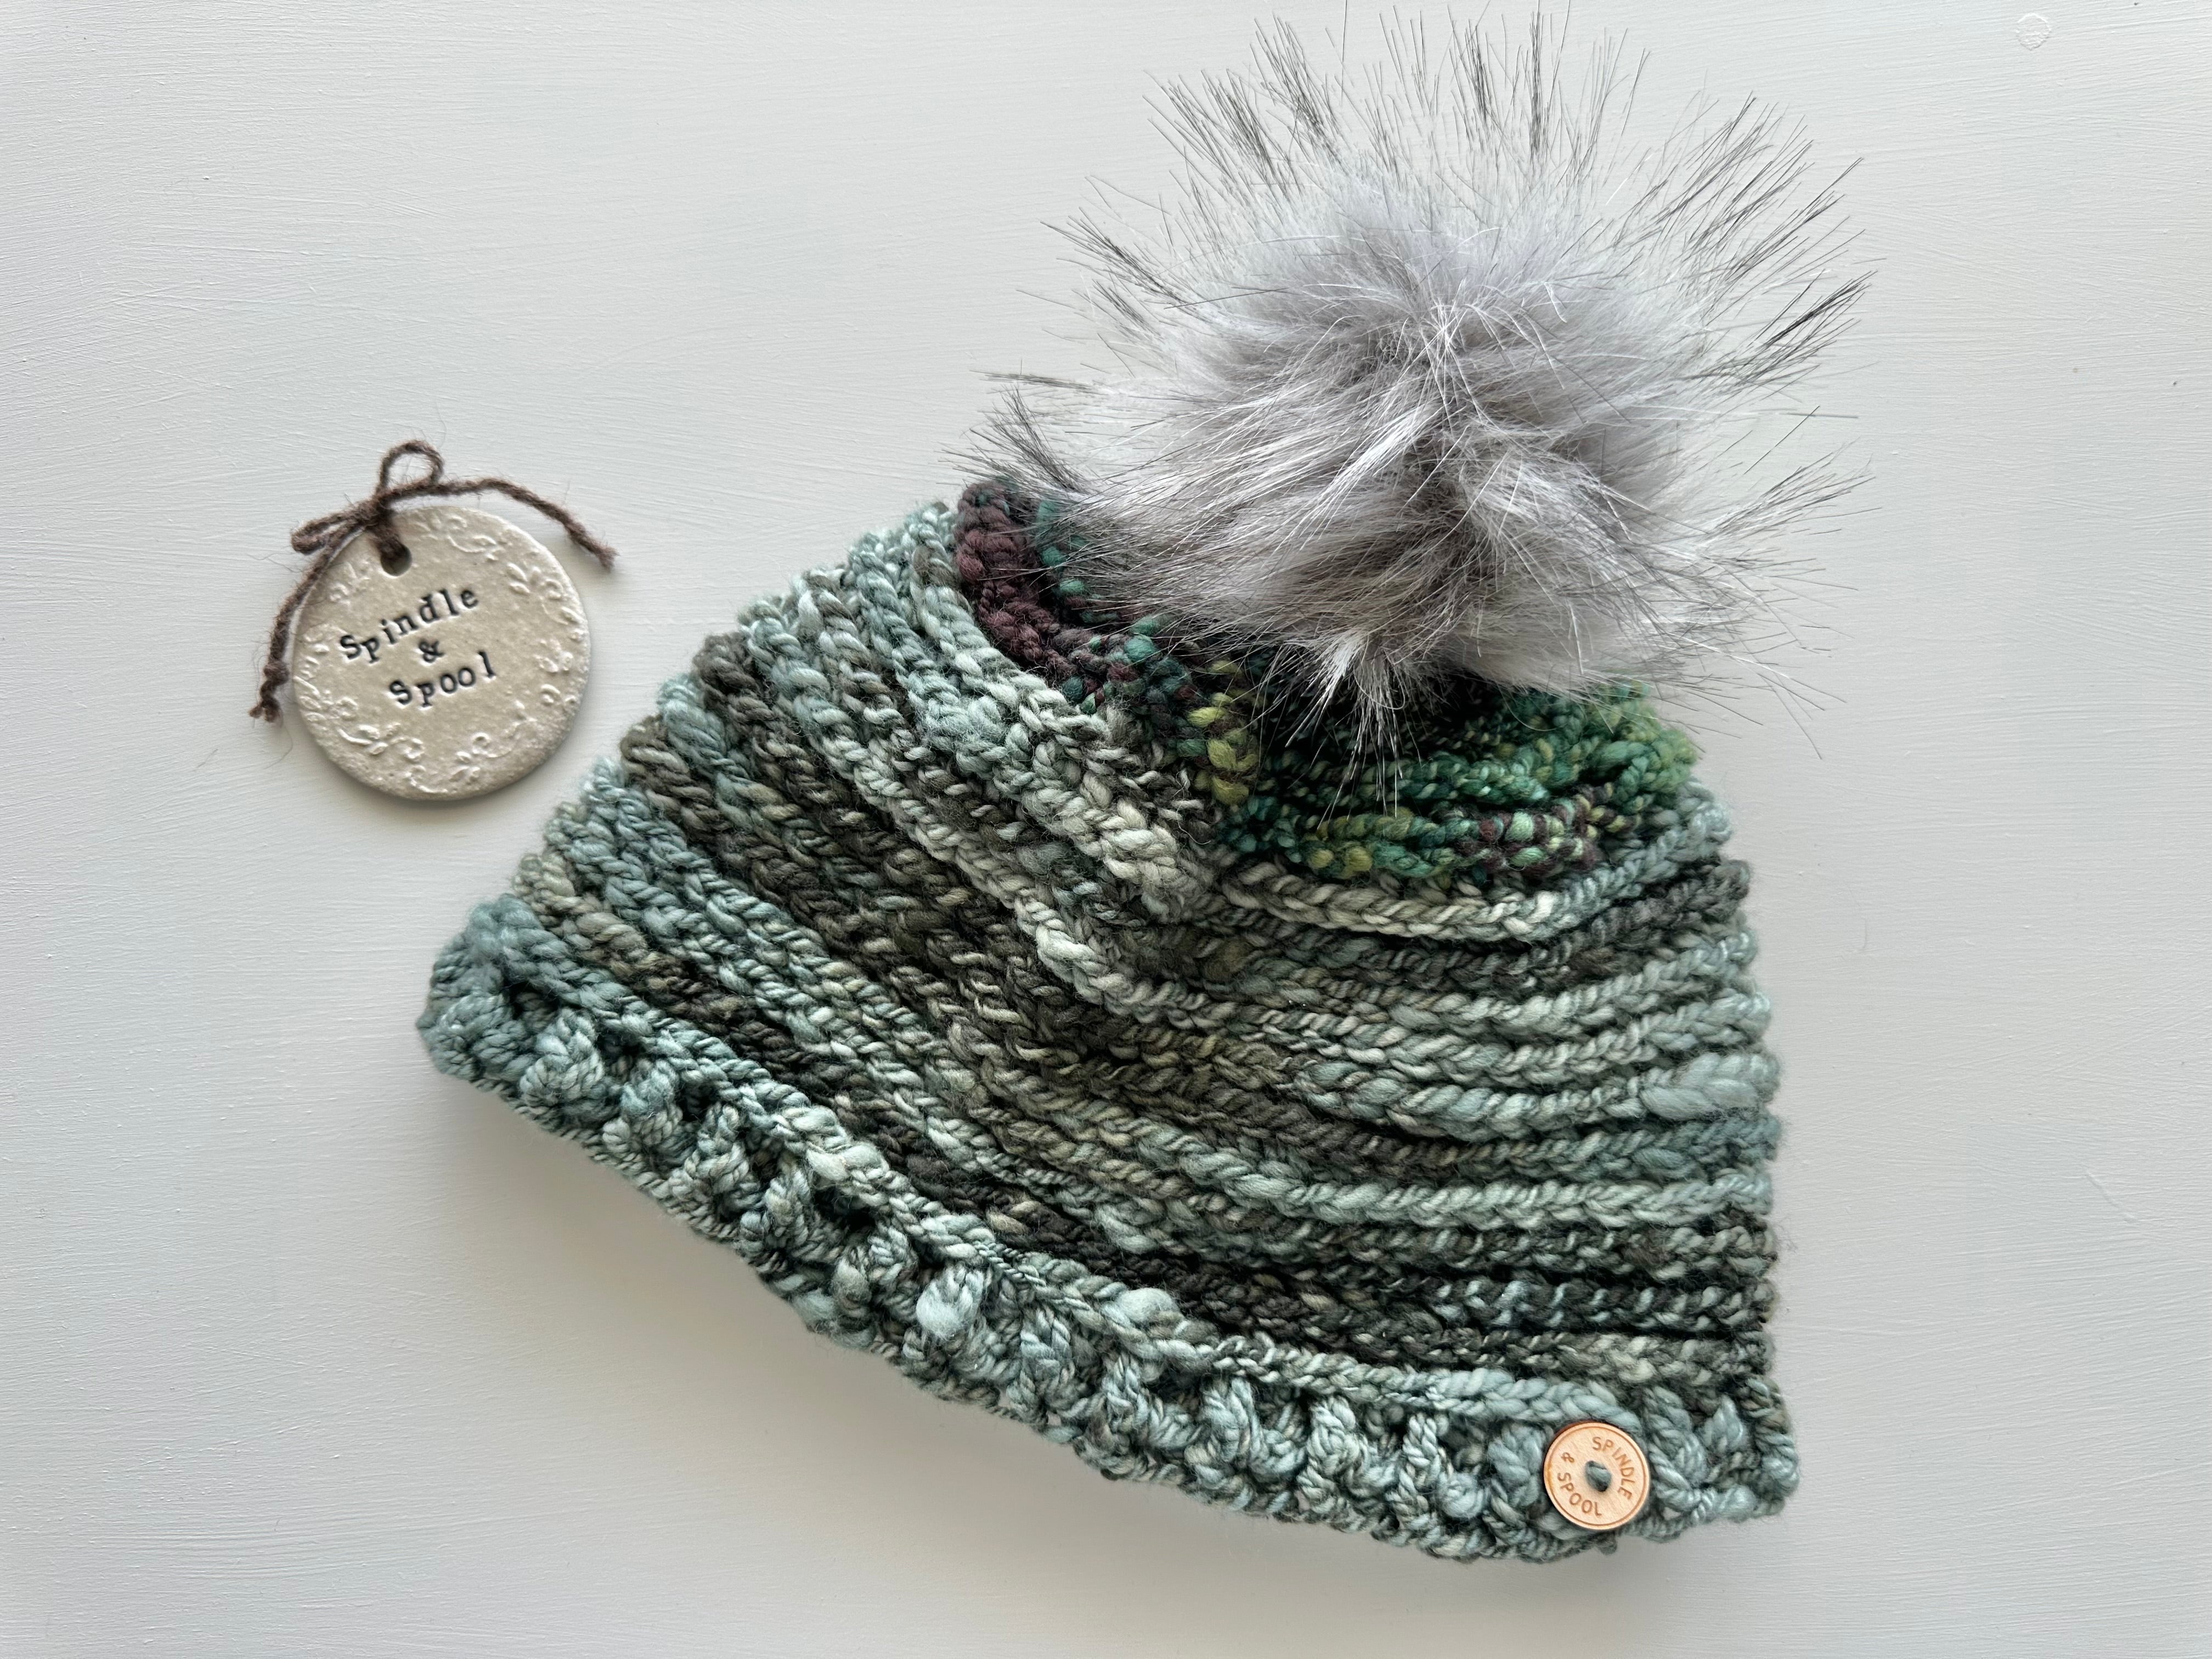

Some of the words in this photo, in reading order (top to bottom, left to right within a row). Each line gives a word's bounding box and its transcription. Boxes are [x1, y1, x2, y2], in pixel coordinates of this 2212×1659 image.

[340, 589, 478, 664] Spindle
[419, 640, 445, 663] &
[390, 651, 496, 708] Spool
[1561, 1452, 1575, 1464] &
[1592, 1436, 1635, 1500] SPINDLE
[1557, 1472, 1602, 1517] SPOOL
